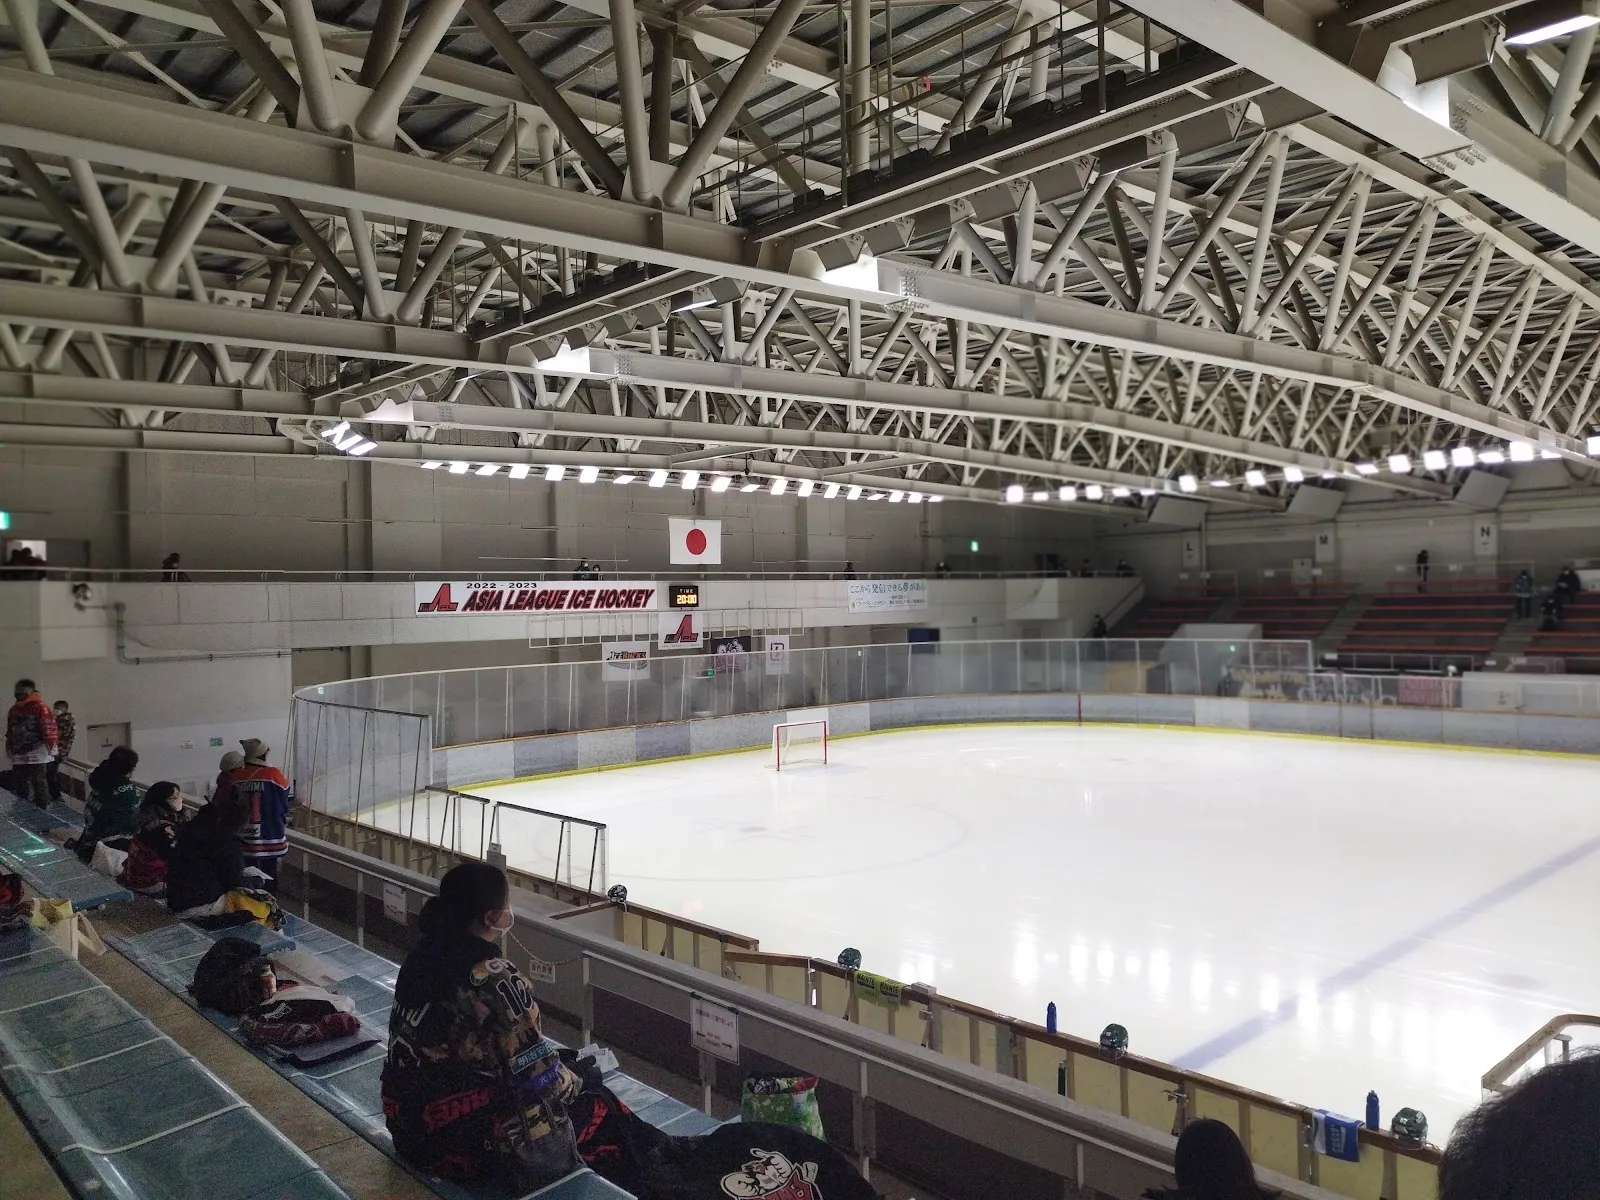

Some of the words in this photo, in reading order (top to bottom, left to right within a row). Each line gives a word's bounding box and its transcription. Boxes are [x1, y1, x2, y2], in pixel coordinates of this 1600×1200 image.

[1481, 526, 1490, 537] N
[1186, 542, 1193, 551] L
[461, 590, 504, 612] ASIA
[503, 589, 570, 611] LEAGUE
[566, 589, 597, 609] ICE
[594, 588, 655, 609] HOCKEY
[676, 594, 697, 605] 20:00
